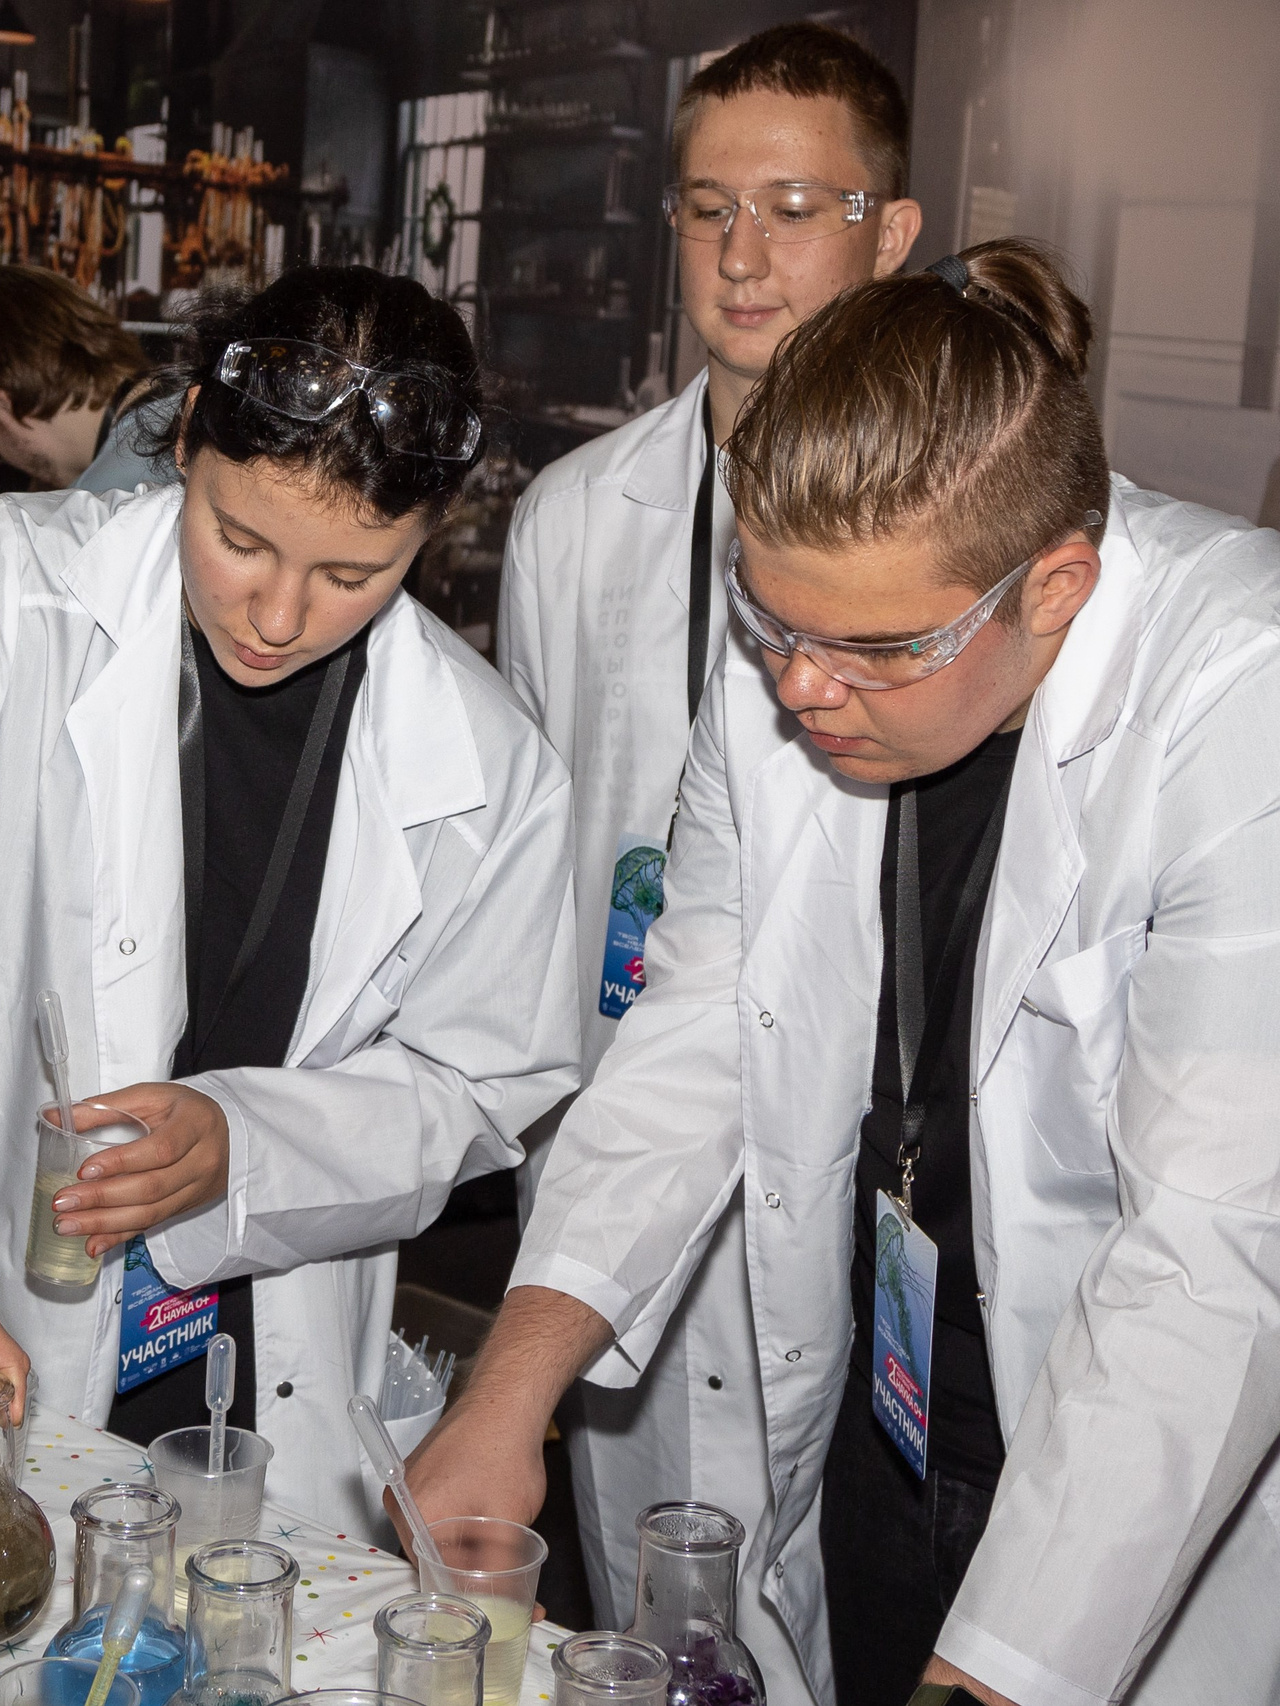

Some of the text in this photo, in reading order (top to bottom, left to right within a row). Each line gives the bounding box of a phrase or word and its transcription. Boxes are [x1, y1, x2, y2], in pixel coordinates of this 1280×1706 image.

[121, 1312, 214, 1372] УЧАСТНИК
[163, 1301, 195, 1324] НАУКА
[874, 1372, 924, 1456] УЧАСТНИК
